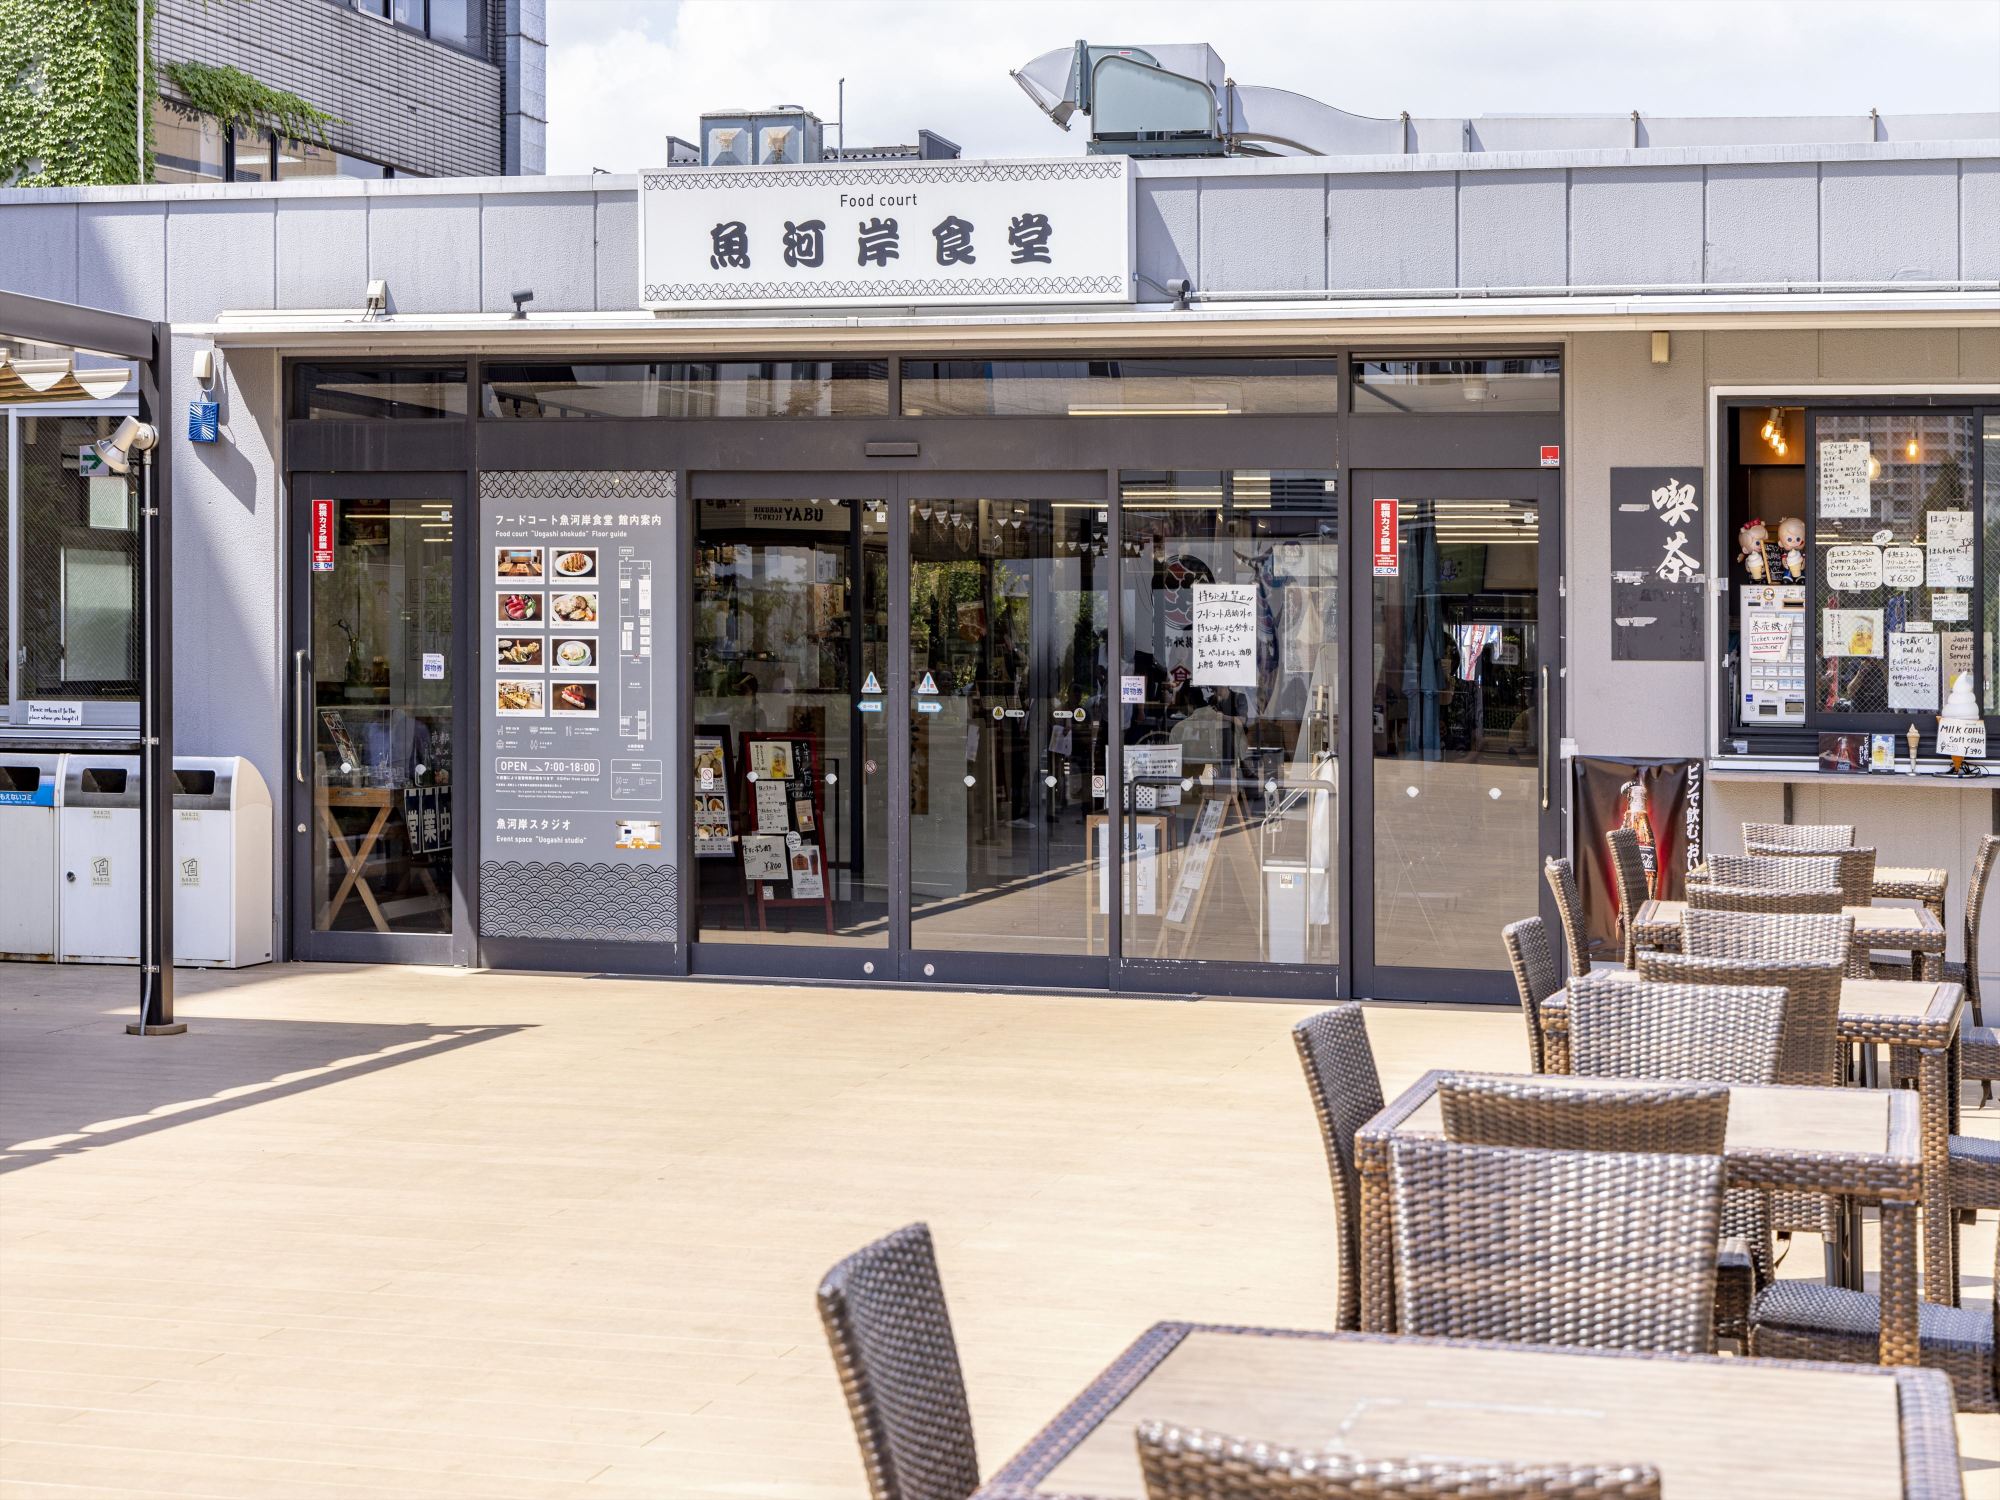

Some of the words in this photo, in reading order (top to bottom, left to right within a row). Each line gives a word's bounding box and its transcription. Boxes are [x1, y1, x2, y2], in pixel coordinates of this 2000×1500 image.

[840, 194, 875, 208] Food
[880, 193, 918, 207] court
[709, 213, 1053, 270] 魚河岸食堂
[784, 507, 824, 522] YABU
[495, 514, 614, 526] フードコート魚河岸食堂
[618, 514, 662, 526] 館内案内
[591, 530, 609, 538] Floor
[609, 530, 628, 539] guide
[1651, 477, 1700, 584] 喫茶
[1889, 575, 1916, 583] ¥630
[1853, 580, 1877, 588] ¥550
[1952, 635, 1974, 643] Japan
[1949, 652, 1971, 660] Served
[423, 664, 443, 672] 買物券
[1122, 687, 1143, 696] 買物券
[1963, 746, 1982, 755] ¥390
[500, 761, 528, 772] OPEN
[544, 761, 595, 773] 7:00-18:00
[408, 806, 451, 845] 営業中
[496, 818, 571, 831] 魚河岸スタジオ
[514, 836, 533, 844] space
